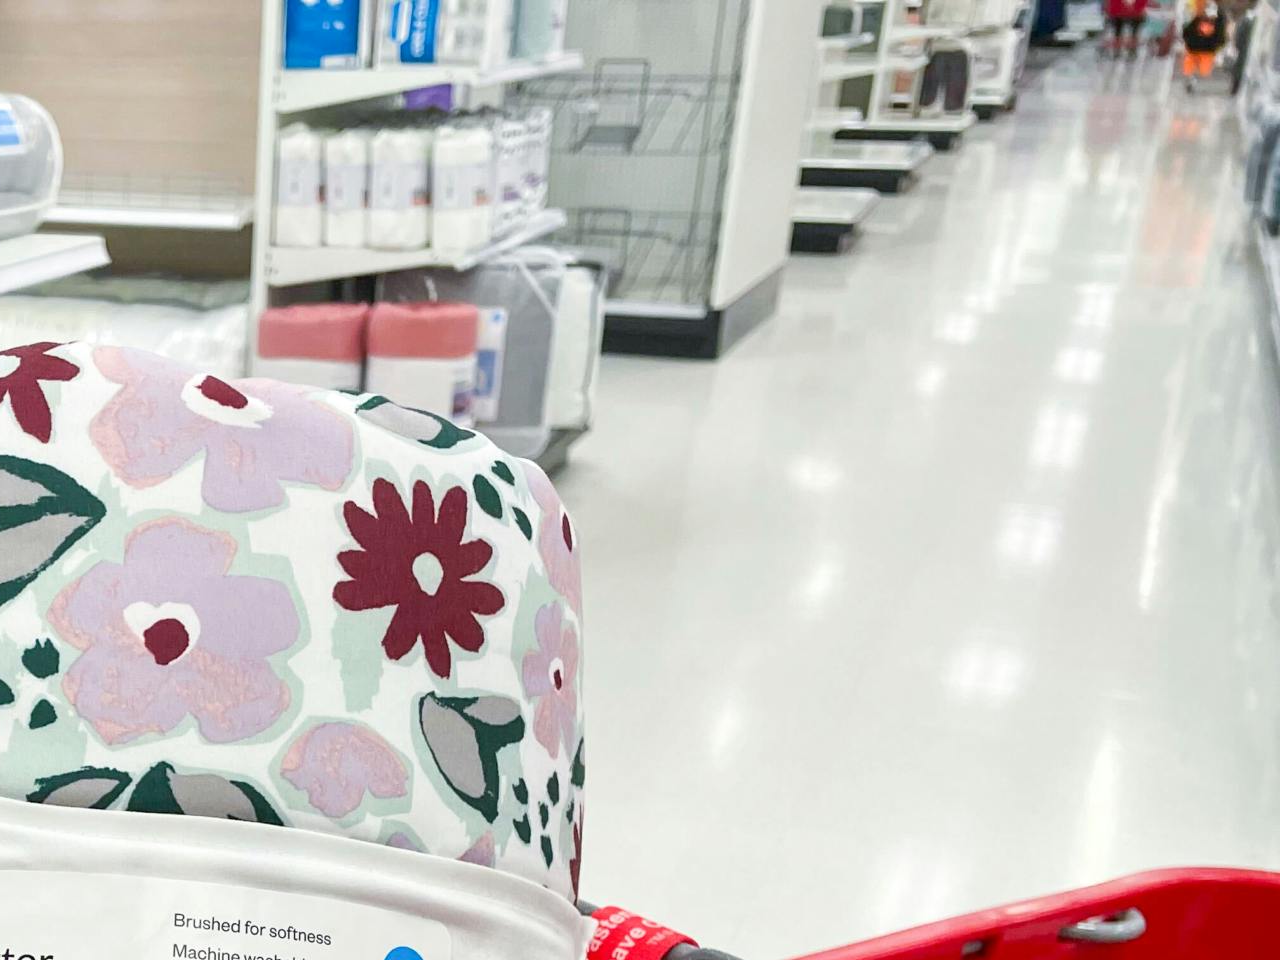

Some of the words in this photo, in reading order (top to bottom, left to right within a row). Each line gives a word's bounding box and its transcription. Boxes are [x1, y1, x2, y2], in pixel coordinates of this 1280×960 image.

[173, 913, 240, 934] Brushed
[244, 920, 266, 938] for
[269, 922, 332, 946] softness
